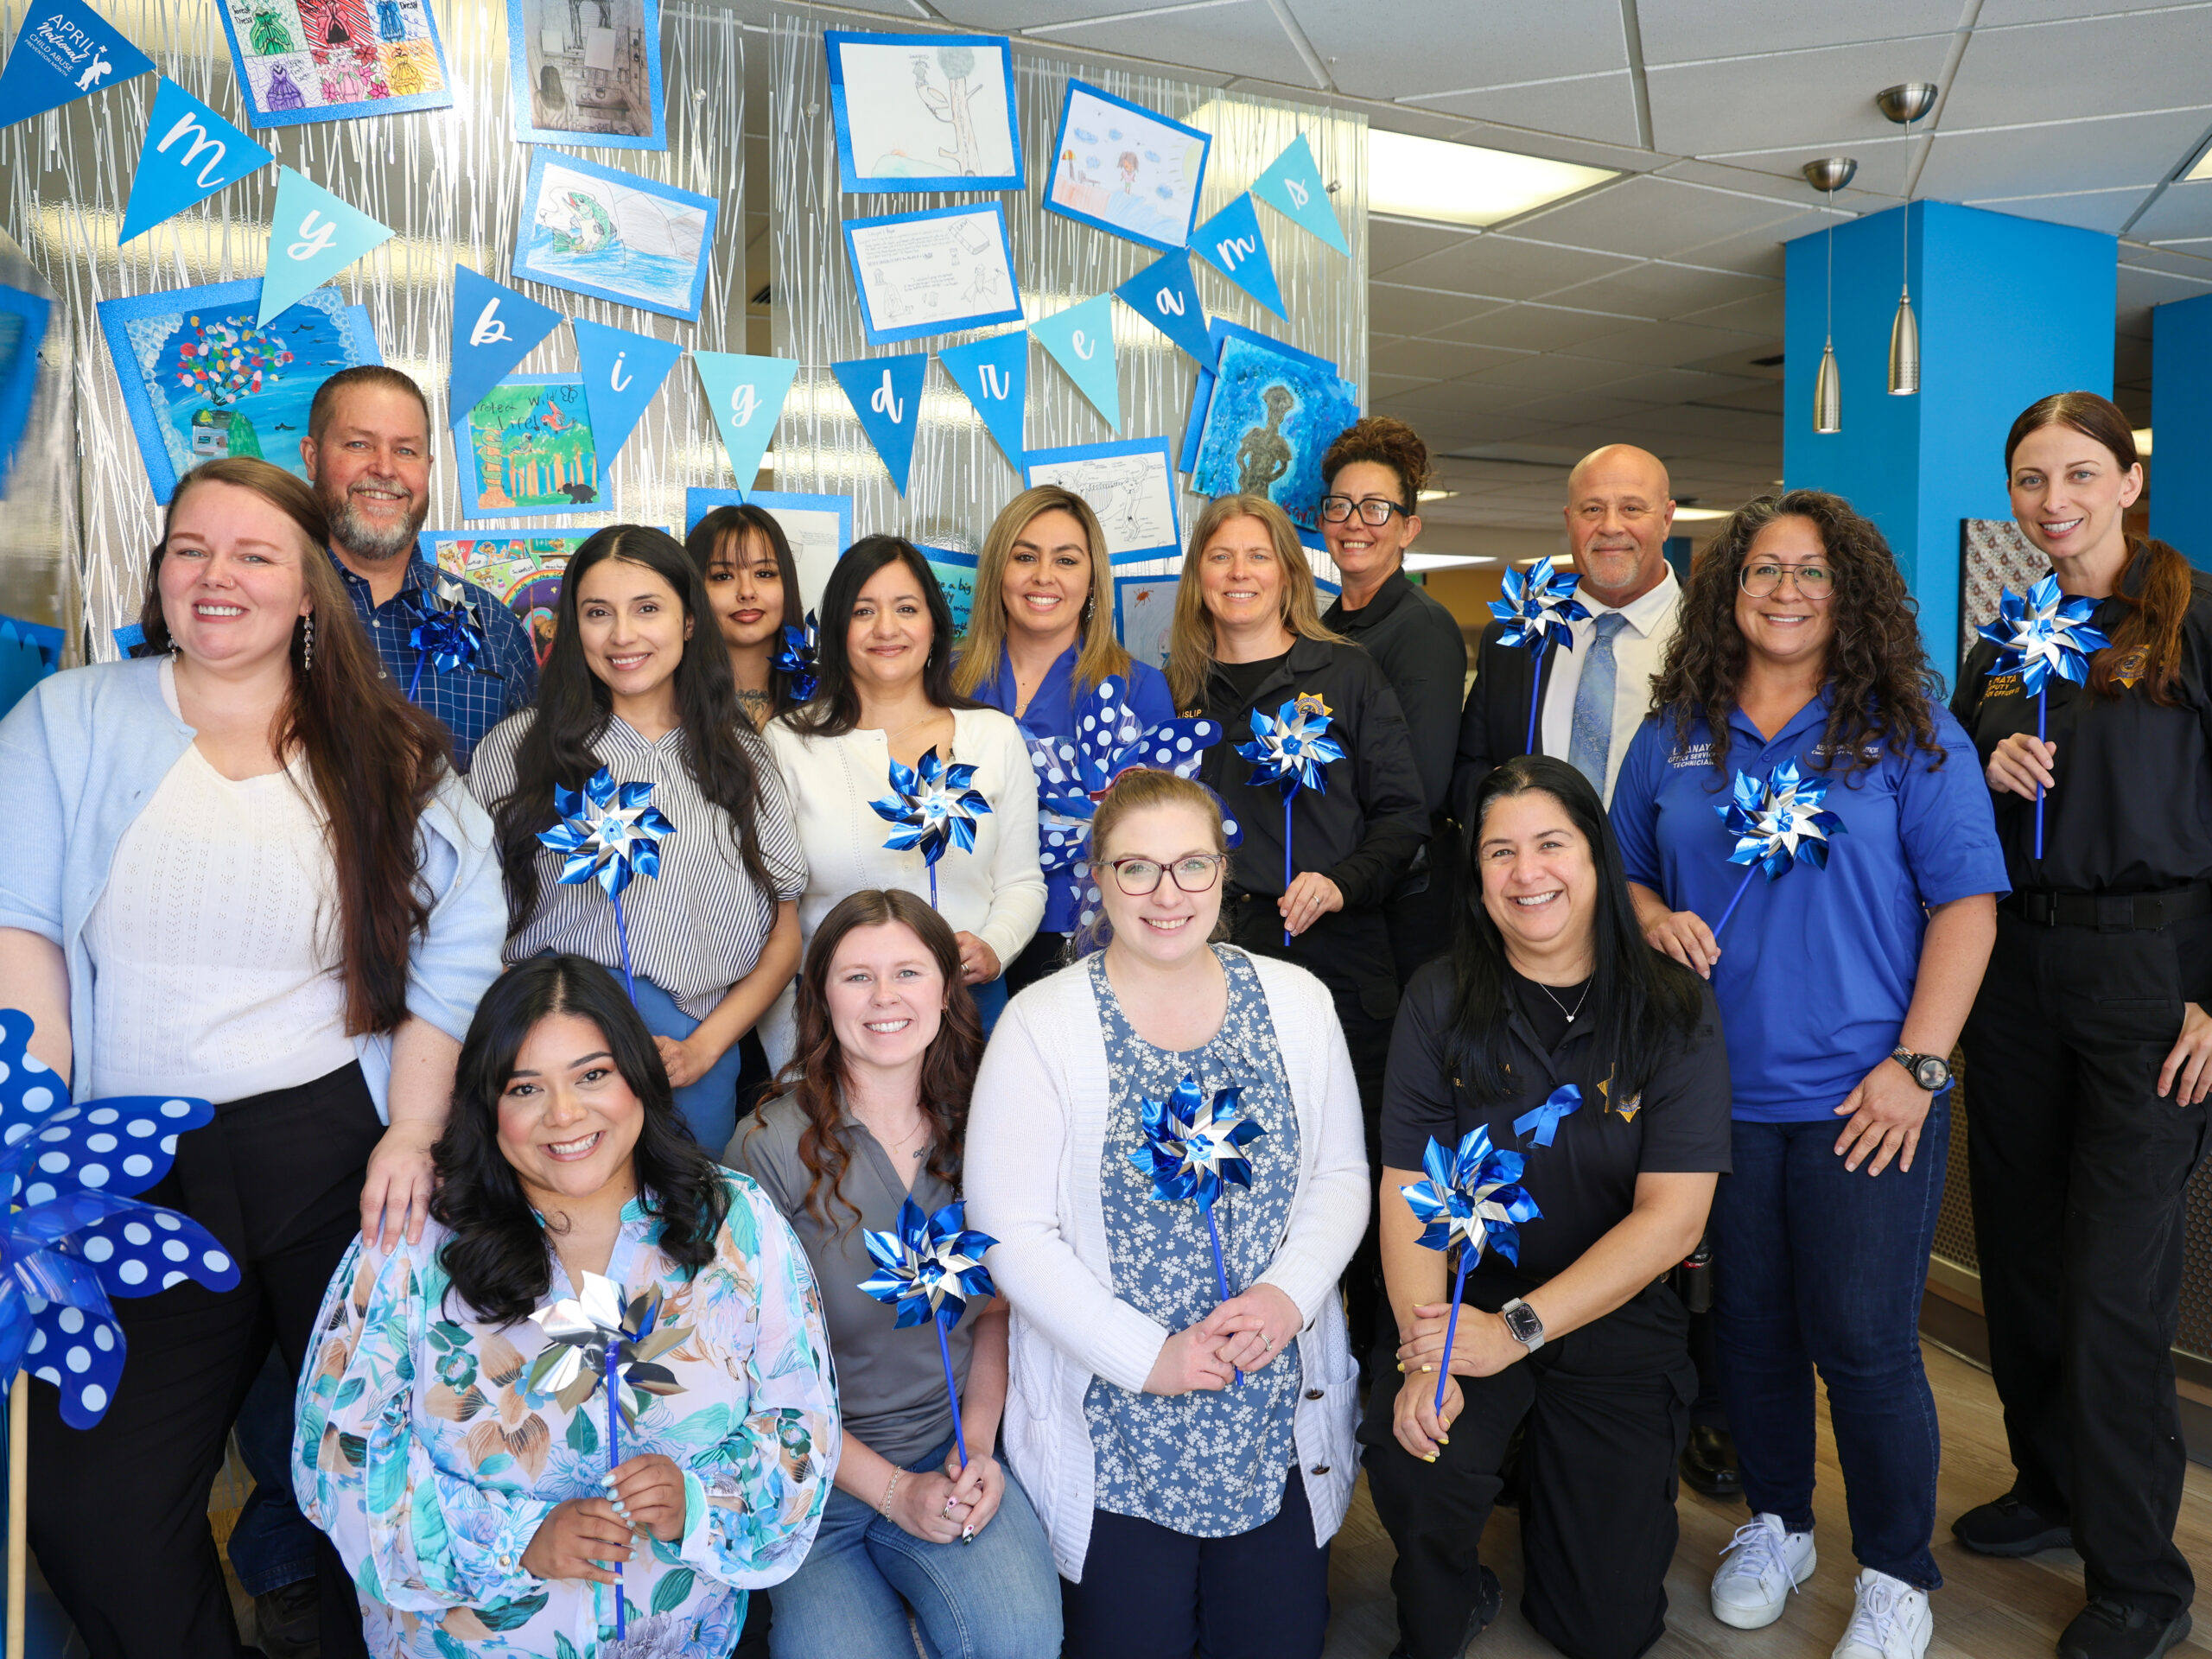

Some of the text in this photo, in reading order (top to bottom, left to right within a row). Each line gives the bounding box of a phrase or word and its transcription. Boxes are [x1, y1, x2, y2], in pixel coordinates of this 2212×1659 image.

[29, 34, 74, 73] CHILD ABUSE
[36, 22, 88, 63] National
[48, 14, 90, 56] APRIL
[24, 39, 68, 78] PREVENTION MONTH
[957, 576, 972, 596] big
[1673, 759, 1714, 769] TECHNICIAN
